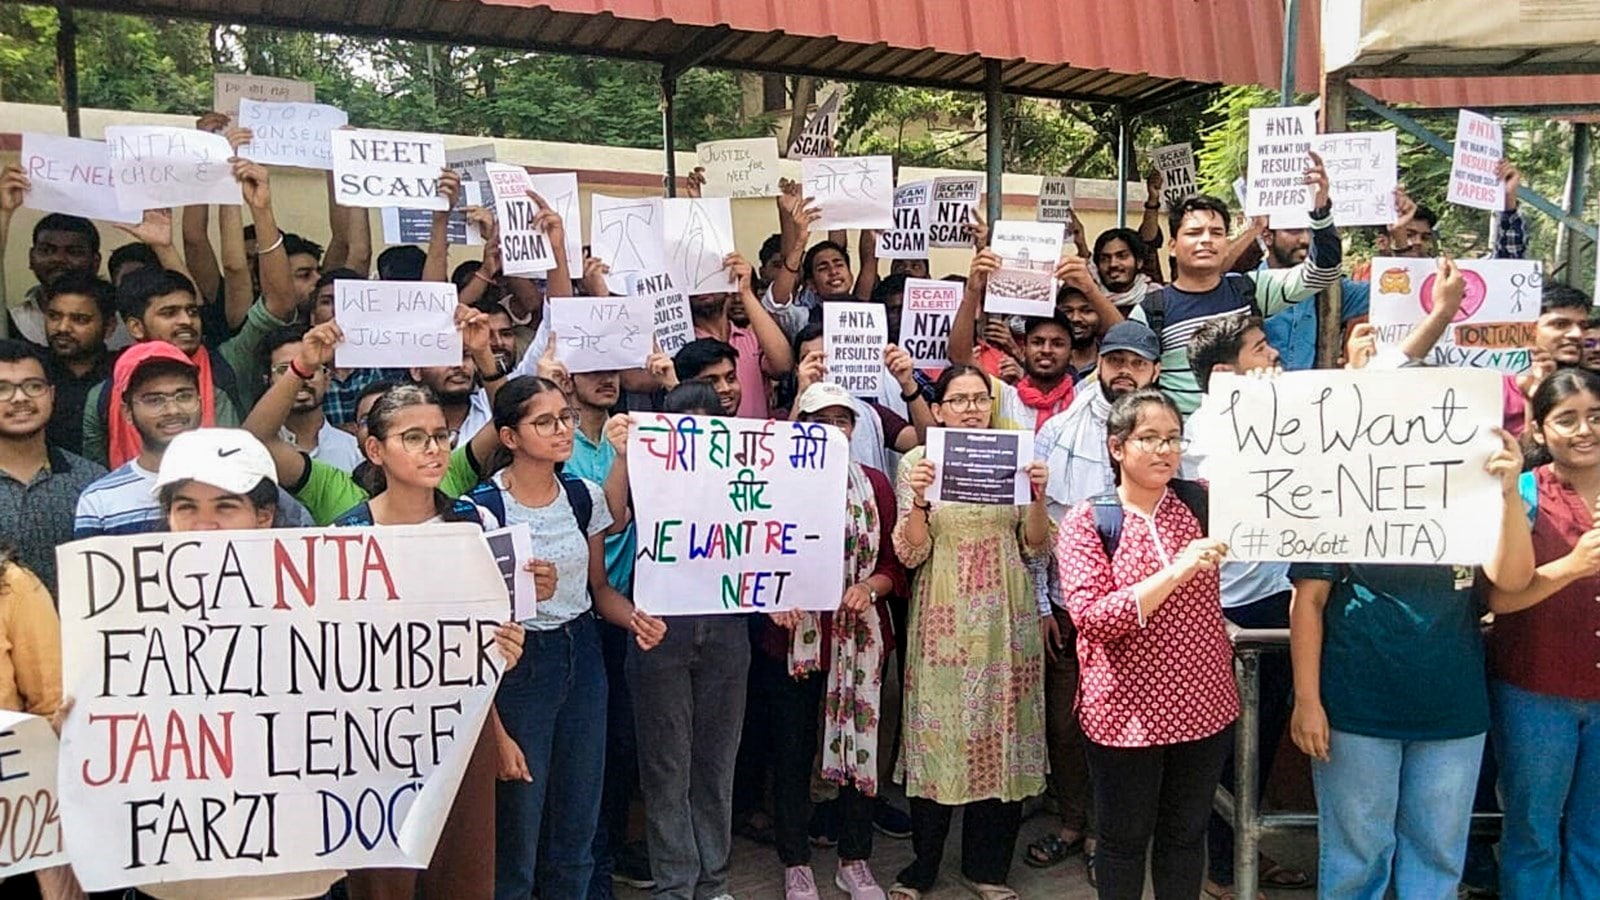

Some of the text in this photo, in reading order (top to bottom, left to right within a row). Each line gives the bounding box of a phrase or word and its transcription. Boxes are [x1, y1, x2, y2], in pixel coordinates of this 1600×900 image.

[1266, 117, 1303, 136] #NTA
[350, 139, 432, 164] NEET
[1258, 142, 1311, 156] WE WANT OUR
[1470, 143, 1487, 154] WANT
[121, 165, 180, 184] CHOR
[1261, 157, 1310, 174] RESULTS
[340, 174, 442, 199] SCAM
[1166, 167, 1191, 187] NTA
[1254, 178, 1269, 188] NOT
[1271, 177, 1291, 187] YOUR
[939, 183, 974, 192] SCAM
[1456, 182, 1496, 203] PAPERS
[1258, 189, 1306, 207] PAPERS
[506, 200, 535, 231] NTA
[938, 202, 970, 223] NTA
[882, 232, 925, 251] SCAM
[929, 225, 972, 242] SCAM
[505, 235, 547, 261] SCAM
[636, 272, 673, 296] #NTA
[341, 289, 456, 313] WE WANT
[666, 293, 684, 304] OUR
[912, 290, 953, 299] SCAM
[912, 300, 954, 308] ALERT!
[590, 303, 630, 319] NTA
[653, 307, 684, 325] SULTS
[838, 312, 875, 329] #NTA
[914, 313, 951, 337] NTA
[351, 327, 451, 350] JUSTICE
[659, 333, 687, 352] PERS
[832, 335, 882, 345] WE WANT OUR
[835, 347, 880, 361] RESULTS
[844, 365, 862, 374] YOUR
[863, 364, 881, 373] SOLD
[1220, 382, 1479, 455] We Want
[638, 414, 703, 471] चोरी
[709, 419, 730, 468] हो
[789, 423, 828, 469] मेरी
[728, 469, 772, 511] सीट
[1249, 454, 1464, 519] Re-NEET
[637, 520, 682, 562] WE
[689, 521, 758, 560] WANT
[1364, 519, 1447, 562] NTA)
[77, 534, 400, 620] DEGA NTA
[722, 571, 791, 609] NEET
[95, 617, 504, 700] FARZI NUMBER
[82, 708, 235, 786] JAAN
[123, 791, 279, 870] FARZI
